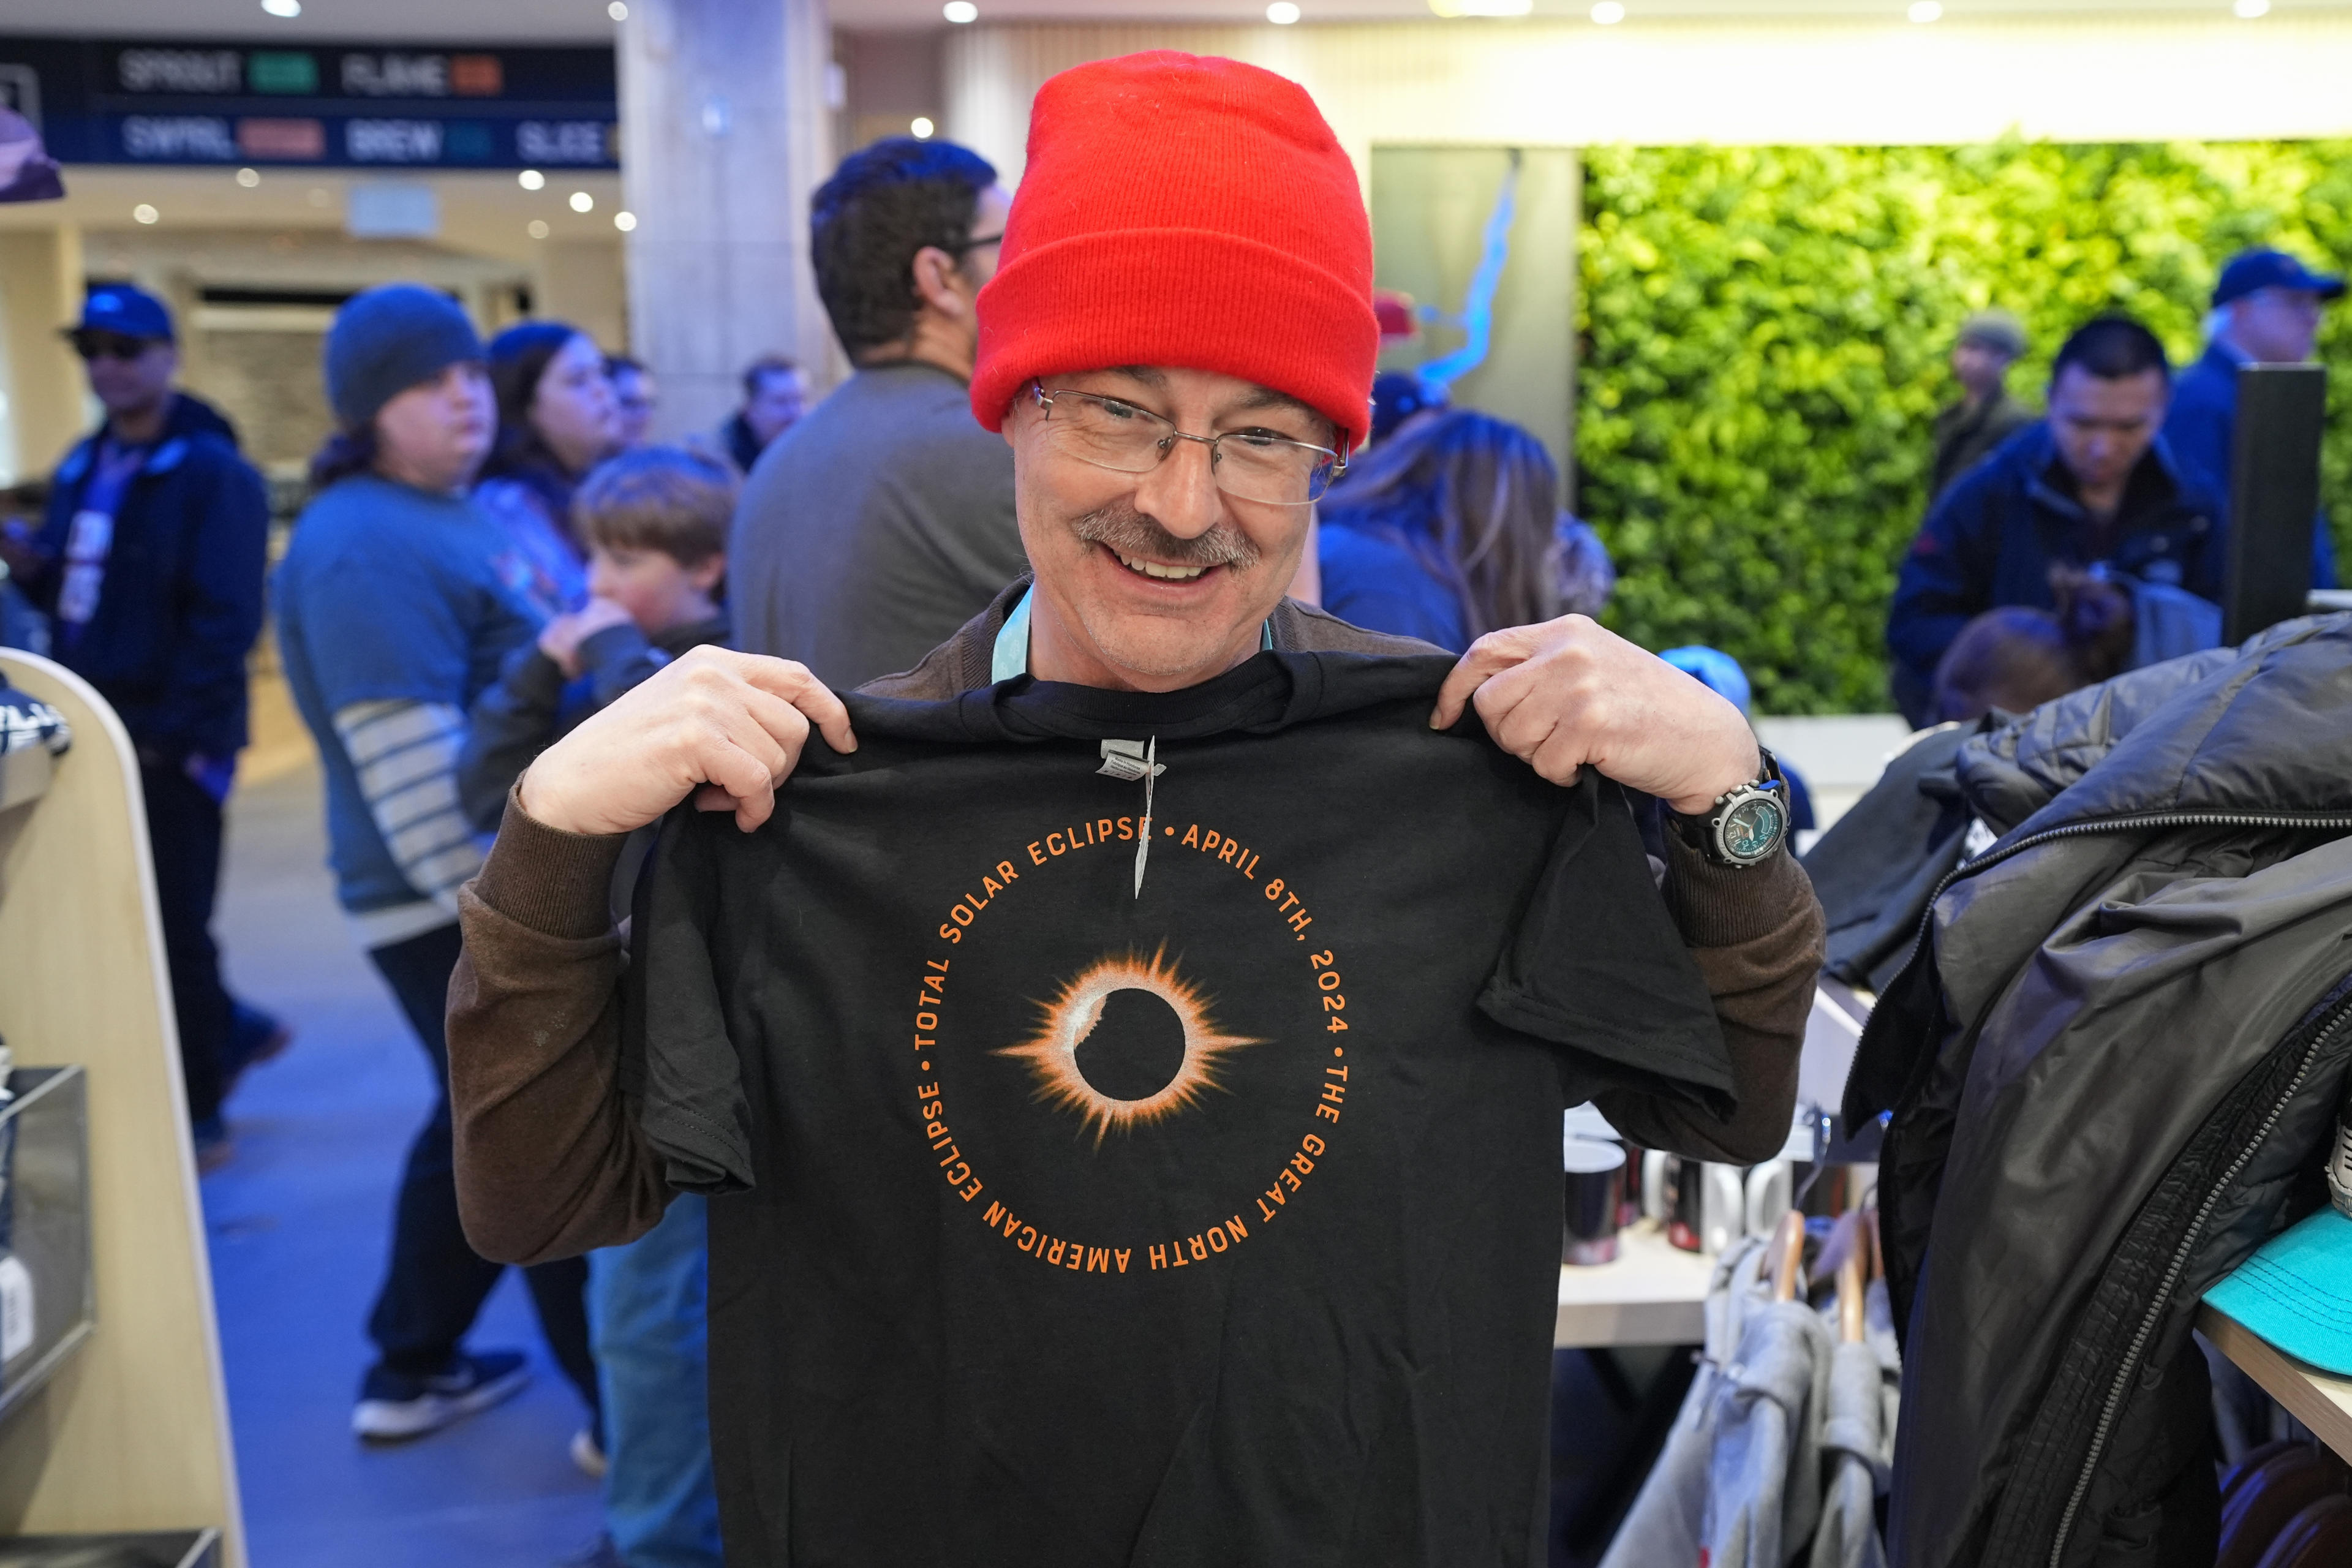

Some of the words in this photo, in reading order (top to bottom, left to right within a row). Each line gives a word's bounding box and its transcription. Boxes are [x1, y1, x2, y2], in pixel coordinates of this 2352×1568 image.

[122, 51, 239, 91] SPROUT
[342, 54, 448, 93] FLAME
[347, 121, 441, 159] BREW
[914, 960, 949, 1050] TOTAL
[939, 861, 1019, 944] SOLAR
[1027, 816, 1153, 865] ECLIPSE
[1182, 824, 1260, 880] APRIL
[1265, 878, 1313, 941] 8TH,
[1310, 949, 1348, 1033] 2024
[1316, 1066, 1348, 1123] THE
[918, 1082, 983, 1202] ECLIPSE
[1257, 1134, 1325, 1223] GREAT
[983, 1200, 1131, 1273] AMERICAN
[1149, 1215, 1248, 1270] NORTH
